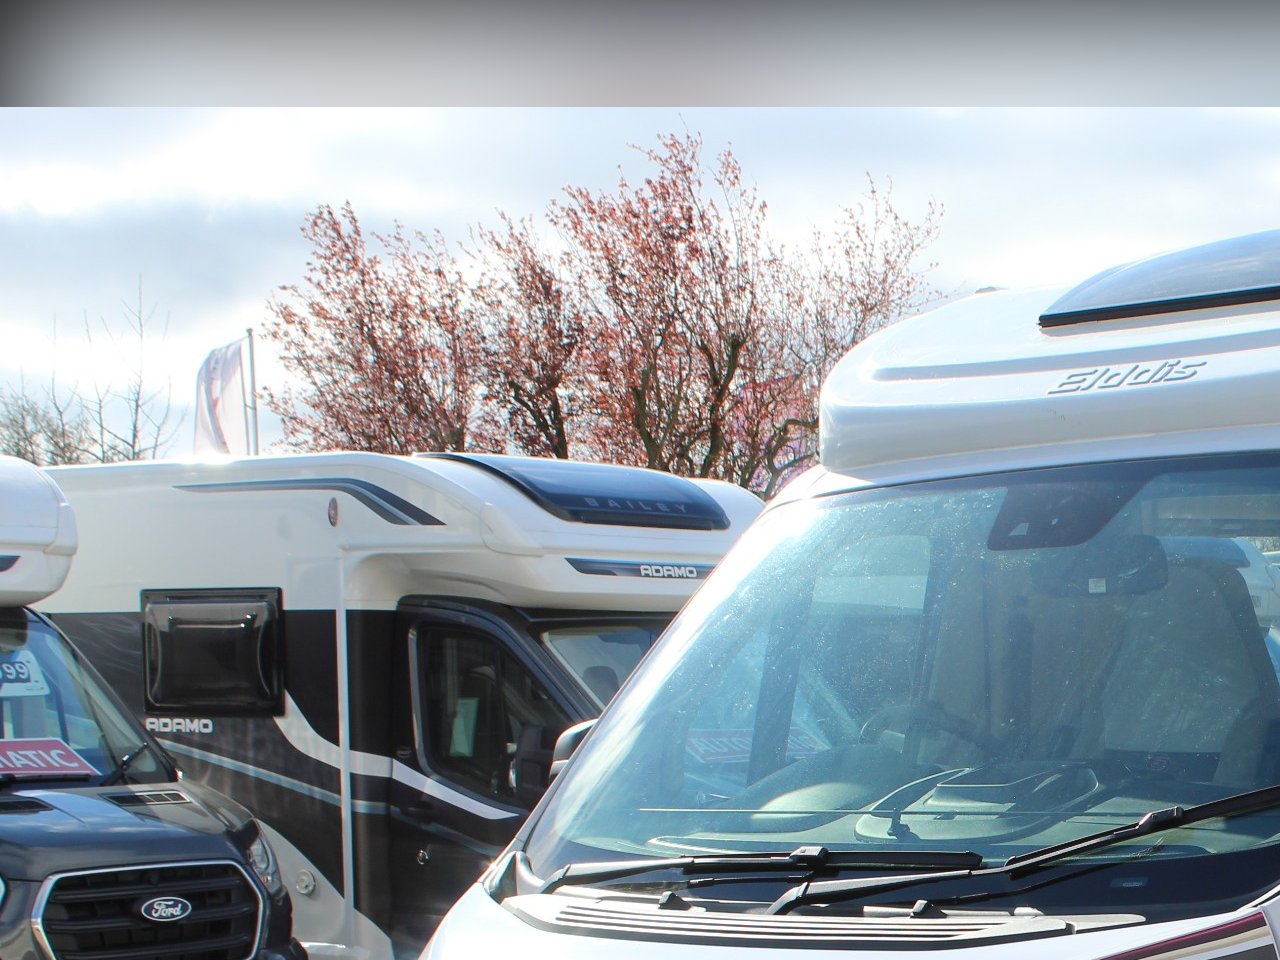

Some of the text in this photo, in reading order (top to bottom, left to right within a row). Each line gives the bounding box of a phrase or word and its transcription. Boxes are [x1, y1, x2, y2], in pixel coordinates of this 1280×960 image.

[583, 496, 687, 514] BAILEY
[639, 564, 698, 579] ADAMO
[0, 661, 30, 680] 99
[145, 717, 214, 734] ADAMO
[151, 900, 183, 917] Ford
